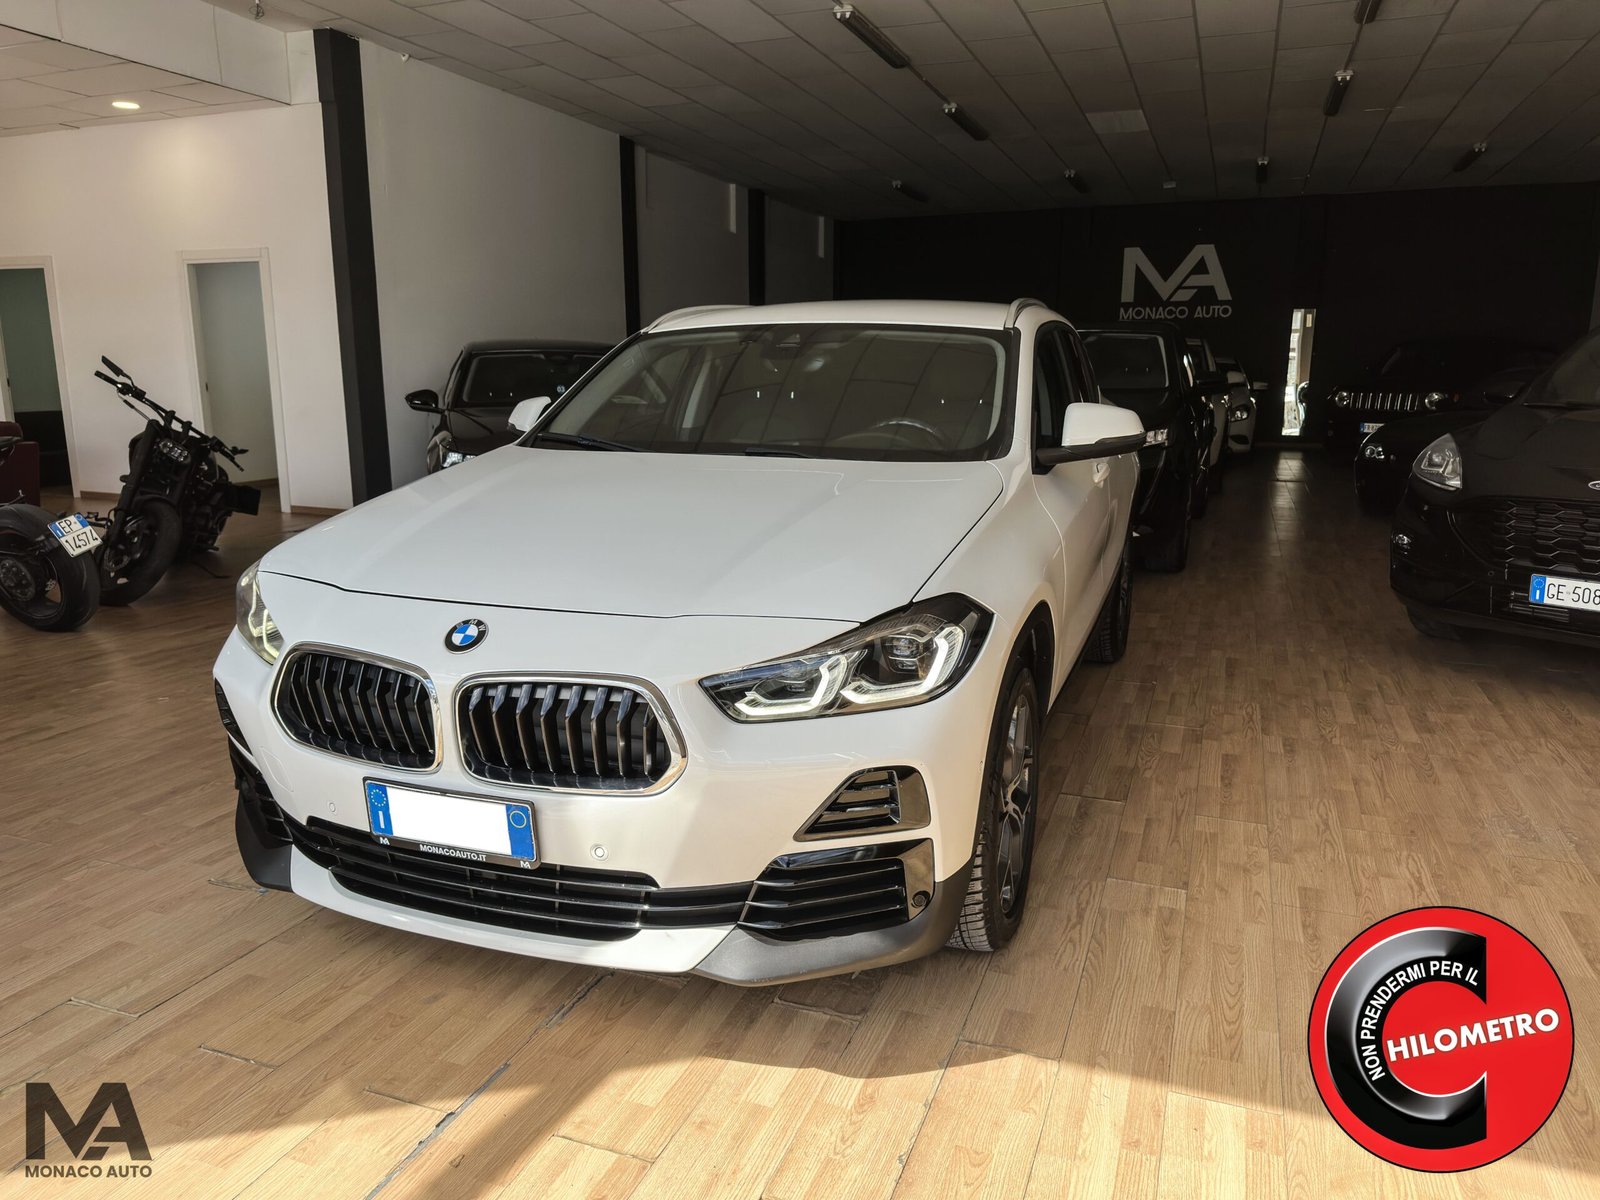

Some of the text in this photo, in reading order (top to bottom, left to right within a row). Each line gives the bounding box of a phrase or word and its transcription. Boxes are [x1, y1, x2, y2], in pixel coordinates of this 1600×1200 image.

[1120, 305, 1232, 320] MONACO AUTO
[58, 519, 74, 534] EP
[65, 529, 98, 551] 14574
[1546, 583, 1566, 601] GE
[1571, 586, 1600, 606] 508
[420, 843, 487, 862] MONACOAUTO.IT
